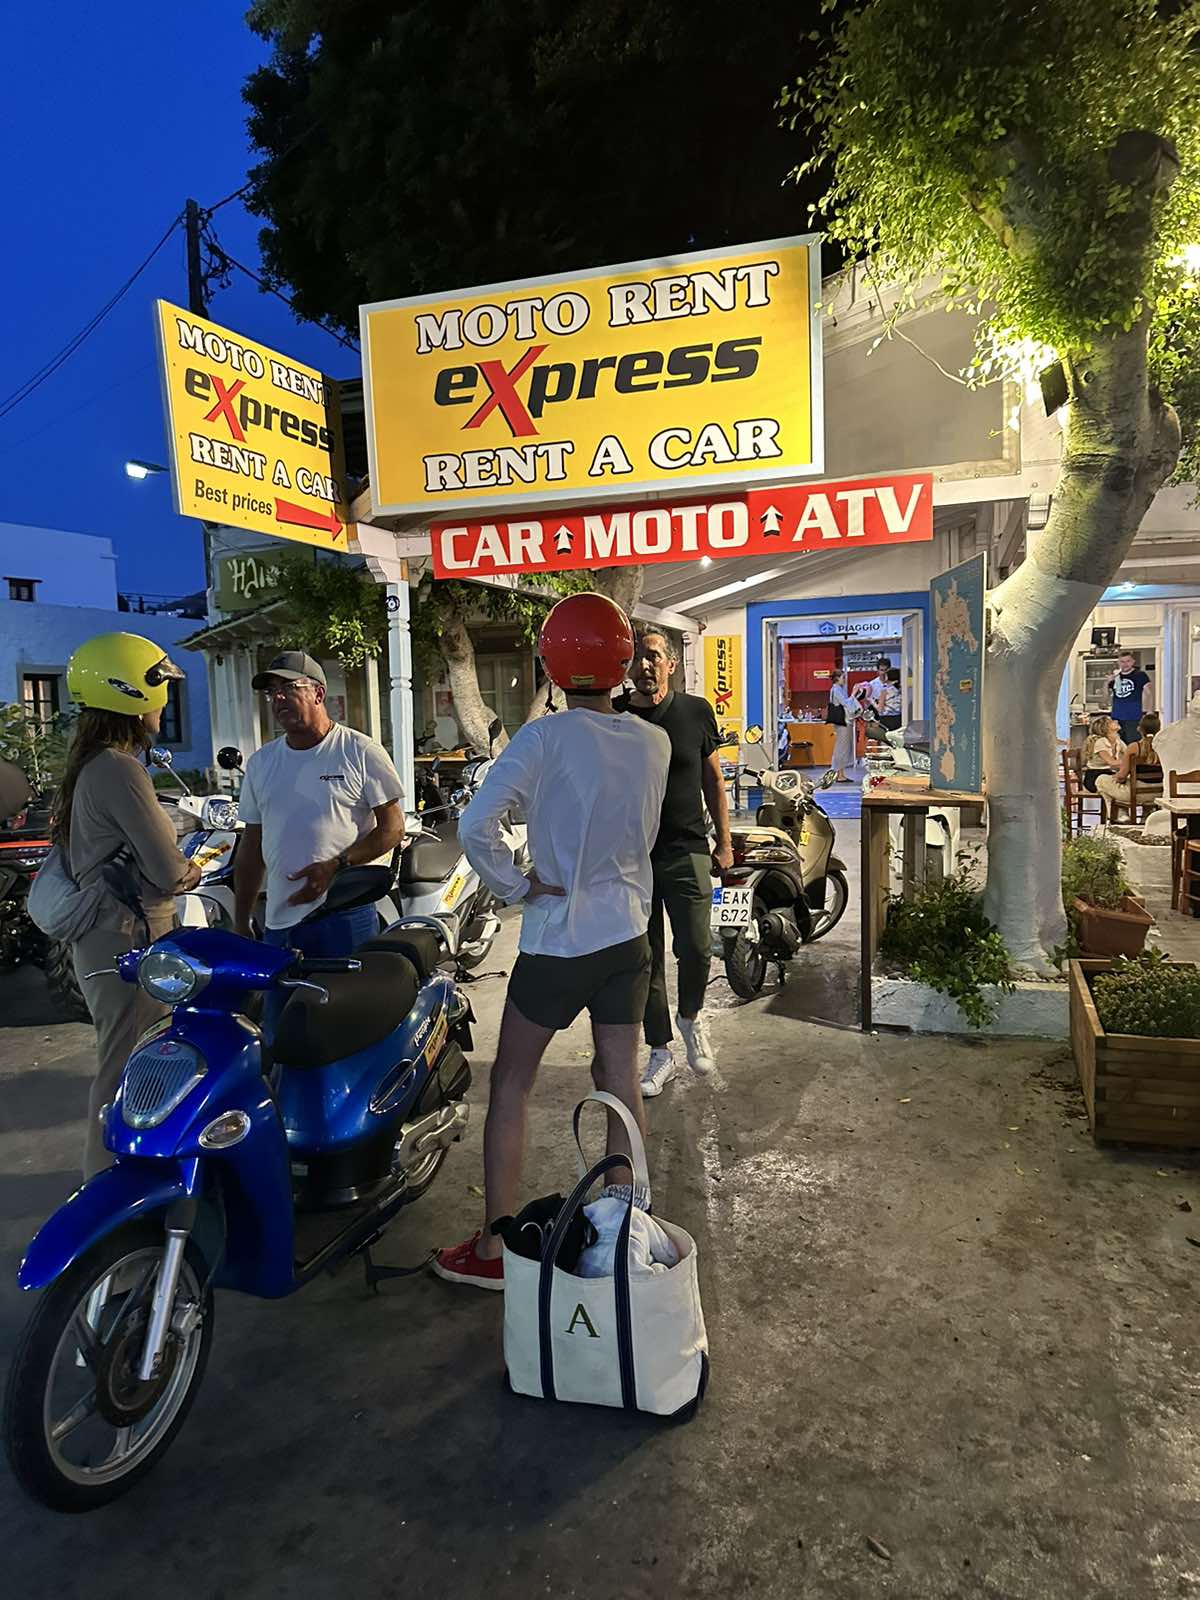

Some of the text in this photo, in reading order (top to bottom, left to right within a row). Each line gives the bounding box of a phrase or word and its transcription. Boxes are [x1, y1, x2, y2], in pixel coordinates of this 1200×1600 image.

[415, 261, 779, 354] MOTO RENT
[176, 319, 332, 408] MOTO RENT
[434, 337, 762, 438] eXpress
[189, 433, 341, 503] RENT A CAR
[422, 418, 782, 491] RENT A CAR
[195, 479, 273, 515] Best prices
[440, 483, 924, 569] CAR MOTO ATV
[838, 623, 880, 632] PIAGGIO
[723, 892, 750, 904] EAK
[565, 1303, 600, 1338] A
